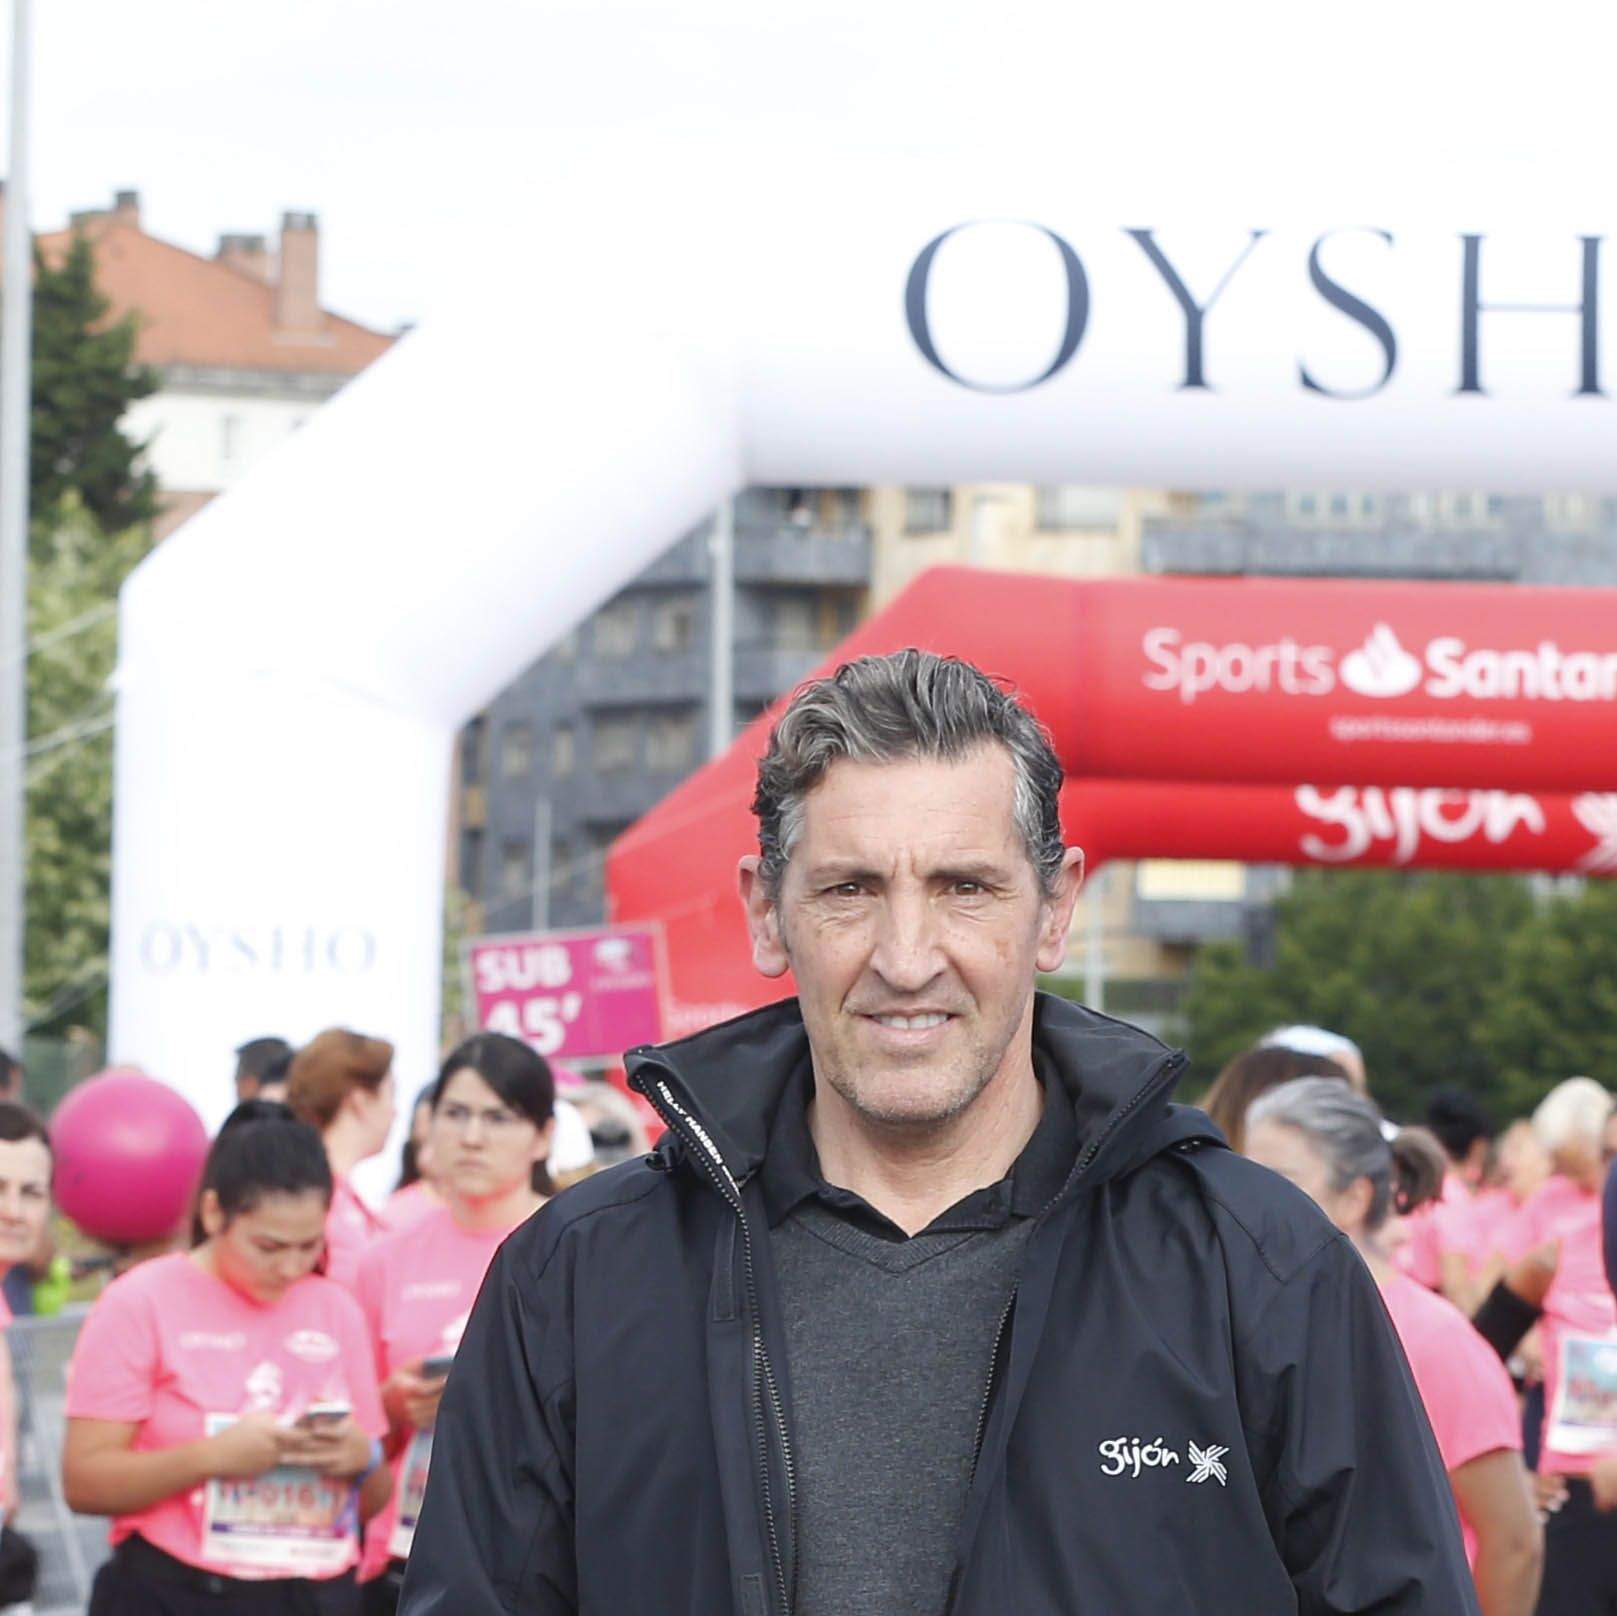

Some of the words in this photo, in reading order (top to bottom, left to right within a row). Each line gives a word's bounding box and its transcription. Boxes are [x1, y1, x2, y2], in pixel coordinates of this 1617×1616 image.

[1141, 626, 1337, 704] Sports
[140, 919, 377, 976] OYSHO
[476, 944, 573, 993] SUB
[656, 1080, 687, 1115] HELLY
[685, 1116, 724, 1165] HANSEN
